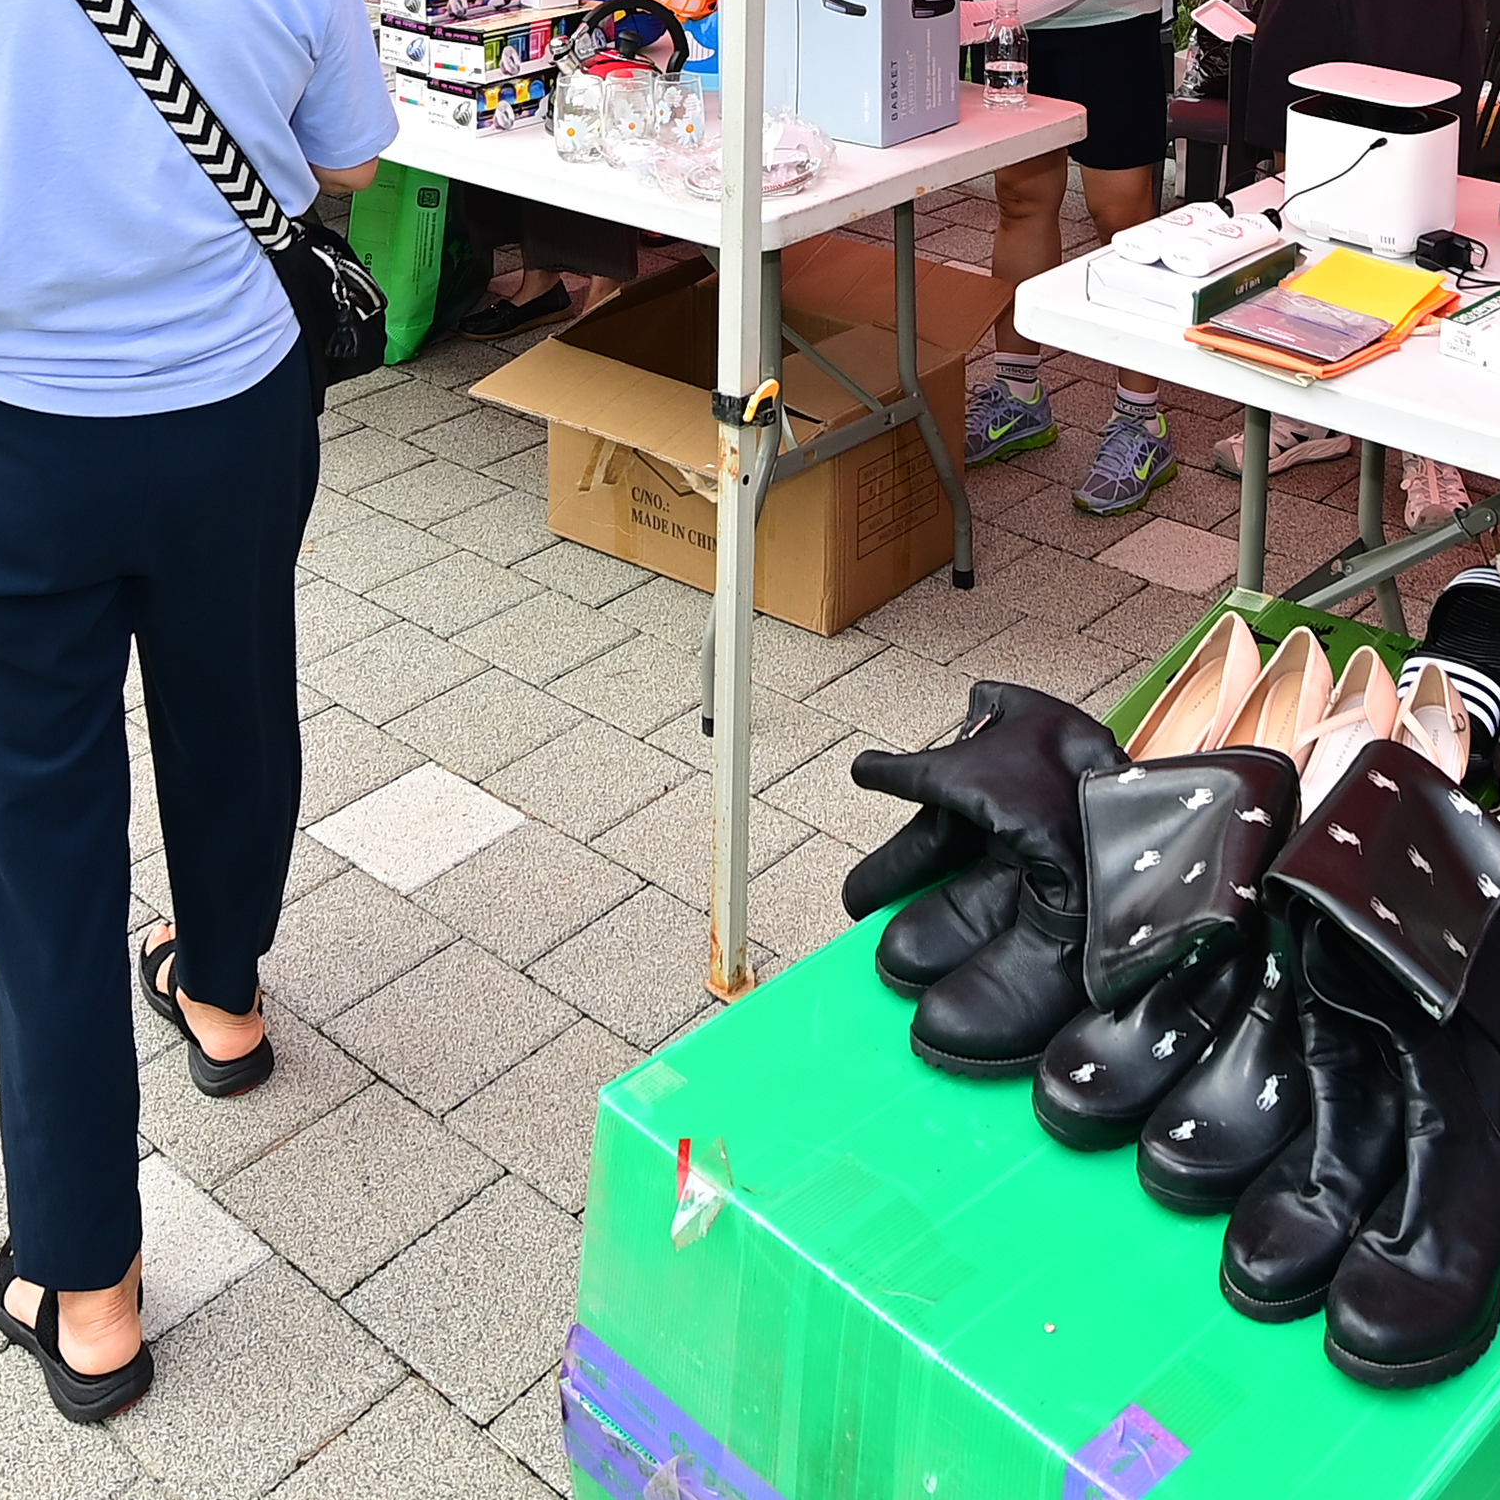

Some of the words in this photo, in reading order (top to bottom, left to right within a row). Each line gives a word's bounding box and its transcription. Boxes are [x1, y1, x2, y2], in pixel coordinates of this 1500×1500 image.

[891, 60, 899, 121] BASKET
[631, 507, 669, 535] MADE
[671, 522, 686, 541] IN
